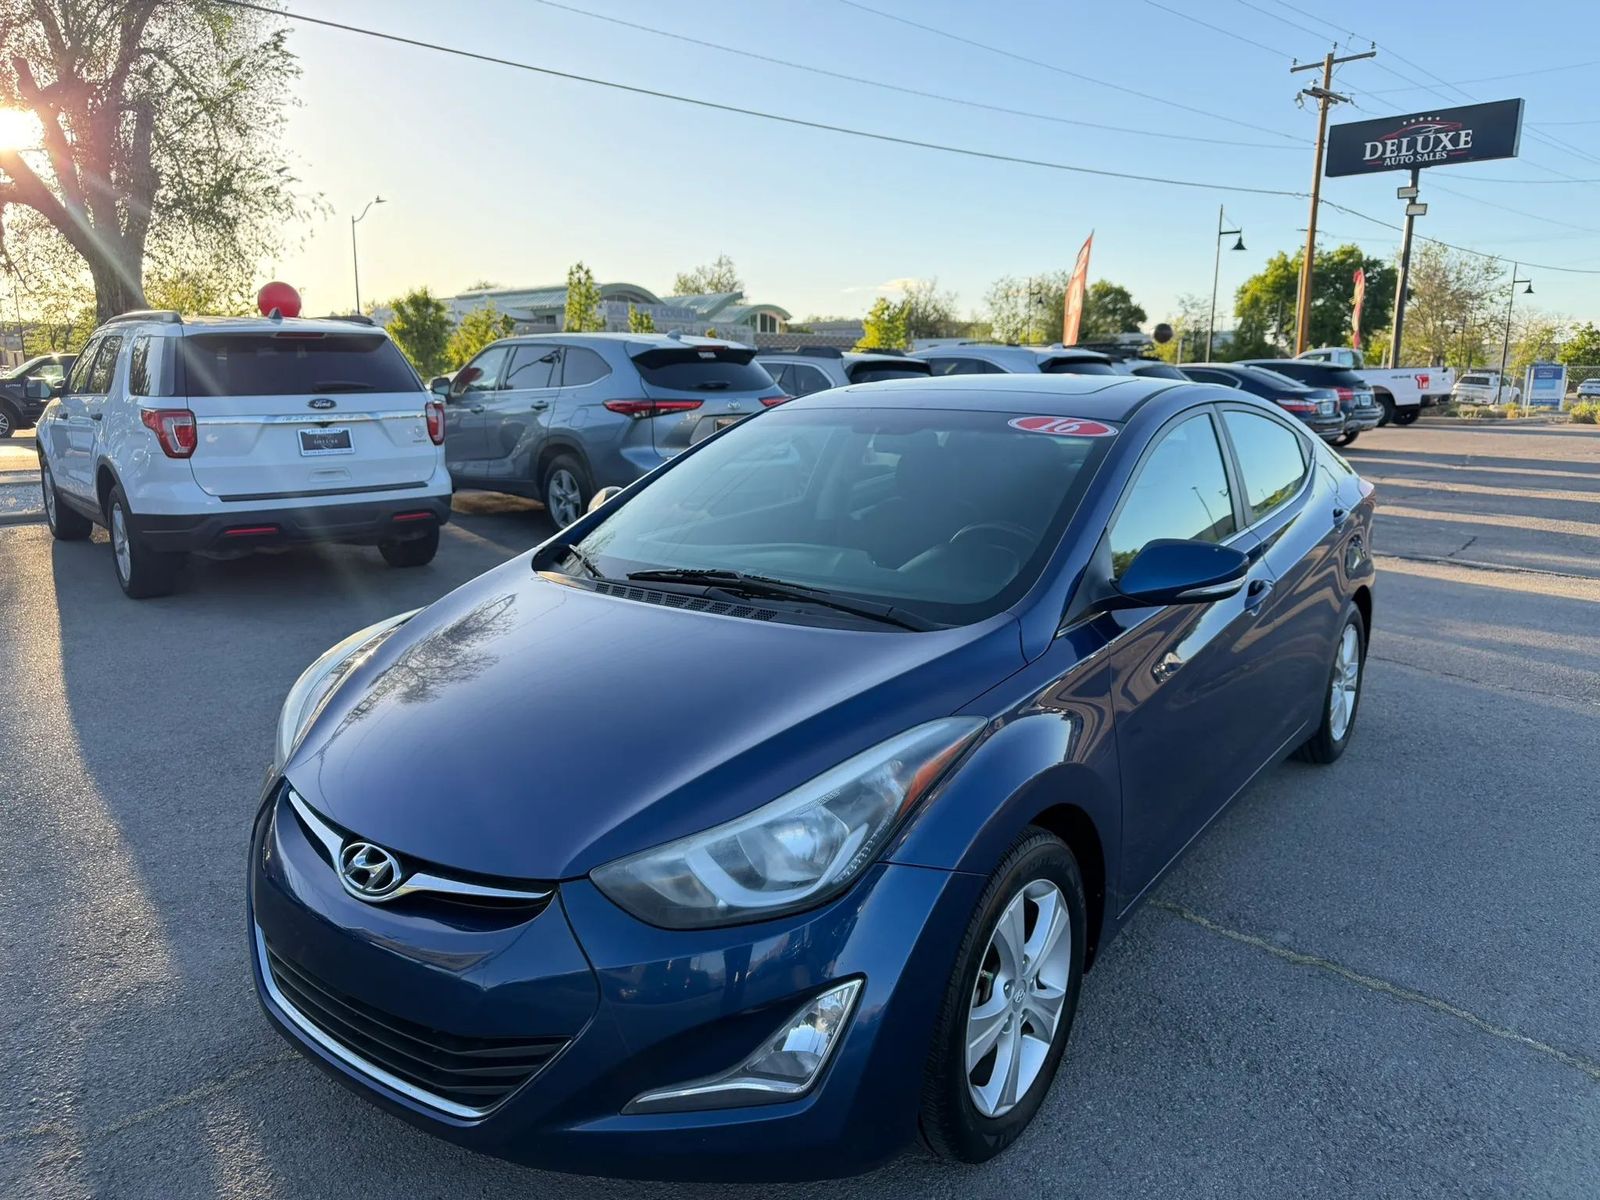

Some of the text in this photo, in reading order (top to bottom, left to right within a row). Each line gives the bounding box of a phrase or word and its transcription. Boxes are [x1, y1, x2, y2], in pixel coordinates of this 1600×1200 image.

[1363, 129, 1472, 160] DELUXE
[1384, 150, 1447, 166] AUTO SALES
[1032, 418, 1086, 433] 16
